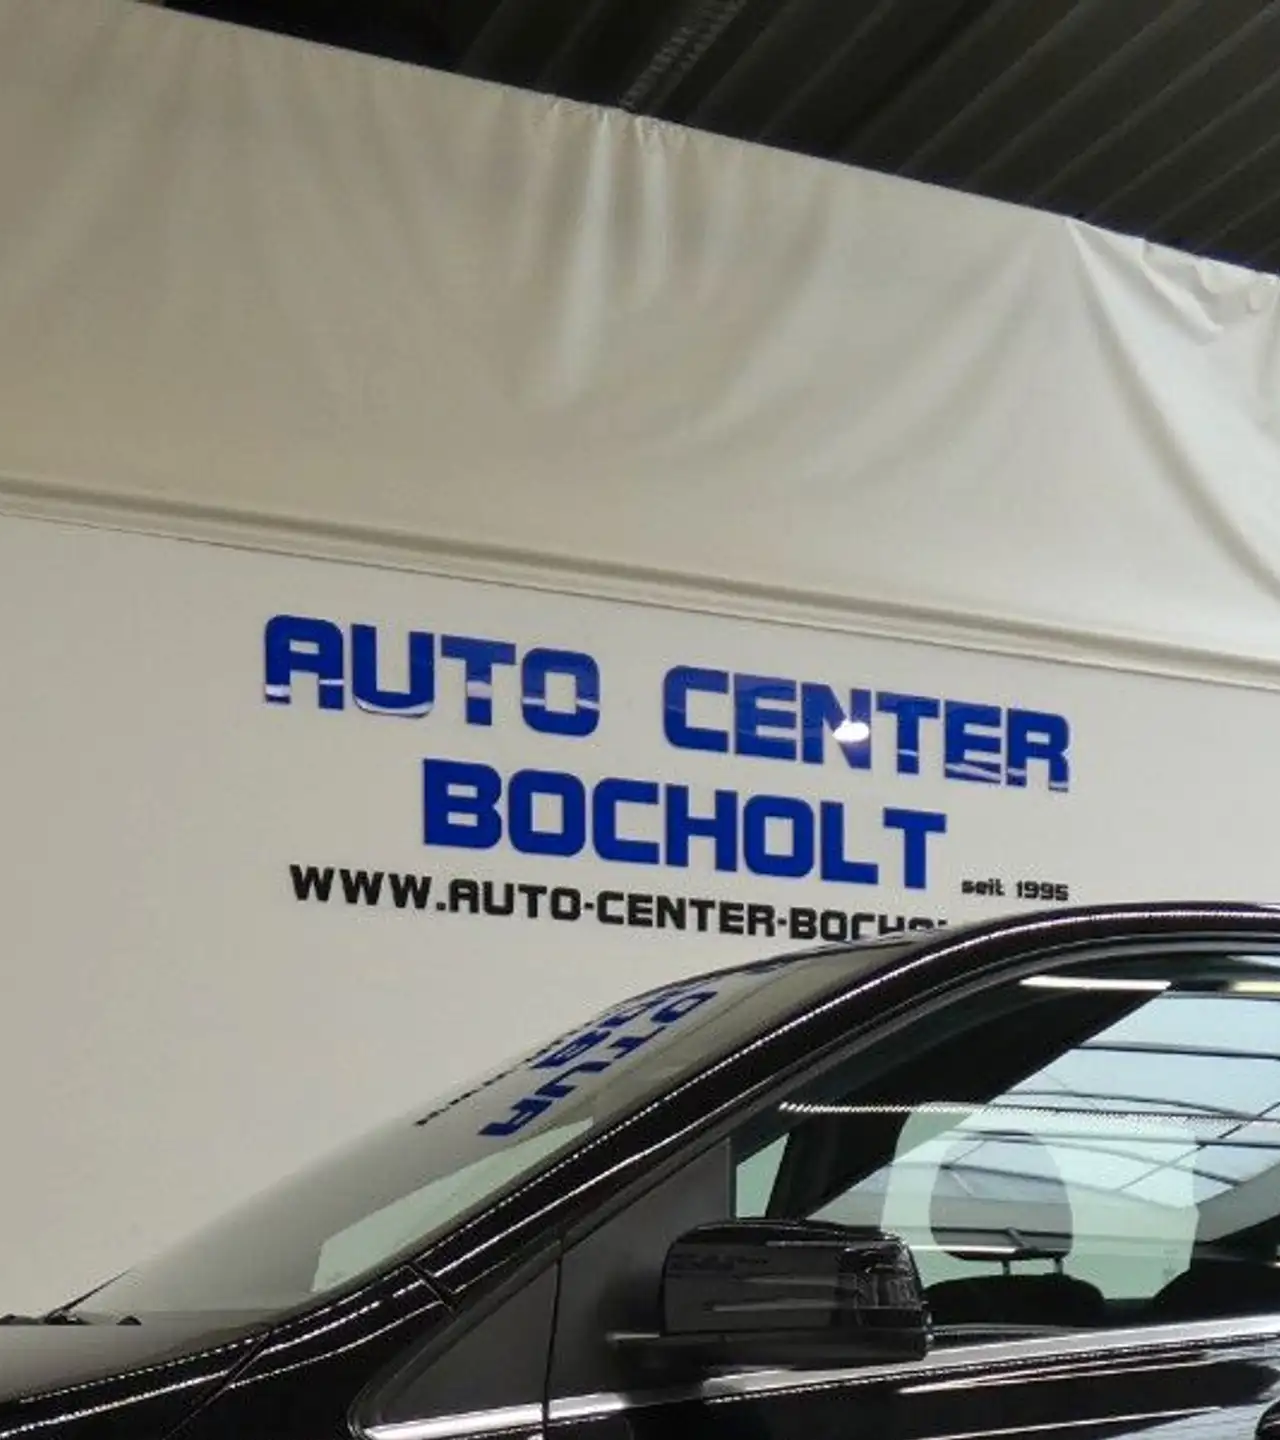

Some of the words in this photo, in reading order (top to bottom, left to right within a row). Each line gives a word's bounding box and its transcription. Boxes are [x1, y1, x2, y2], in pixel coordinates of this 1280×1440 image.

[265, 615, 600, 737] AUTO
[663, 667, 1070, 792] CENTER
[423, 758, 948, 890] BOCHOLT
[289, 863, 949, 944] WWW.AUTO-CENTER-BOCH
[961, 878, 1006, 897] seit
[1016, 880, 1070, 902] 1995
